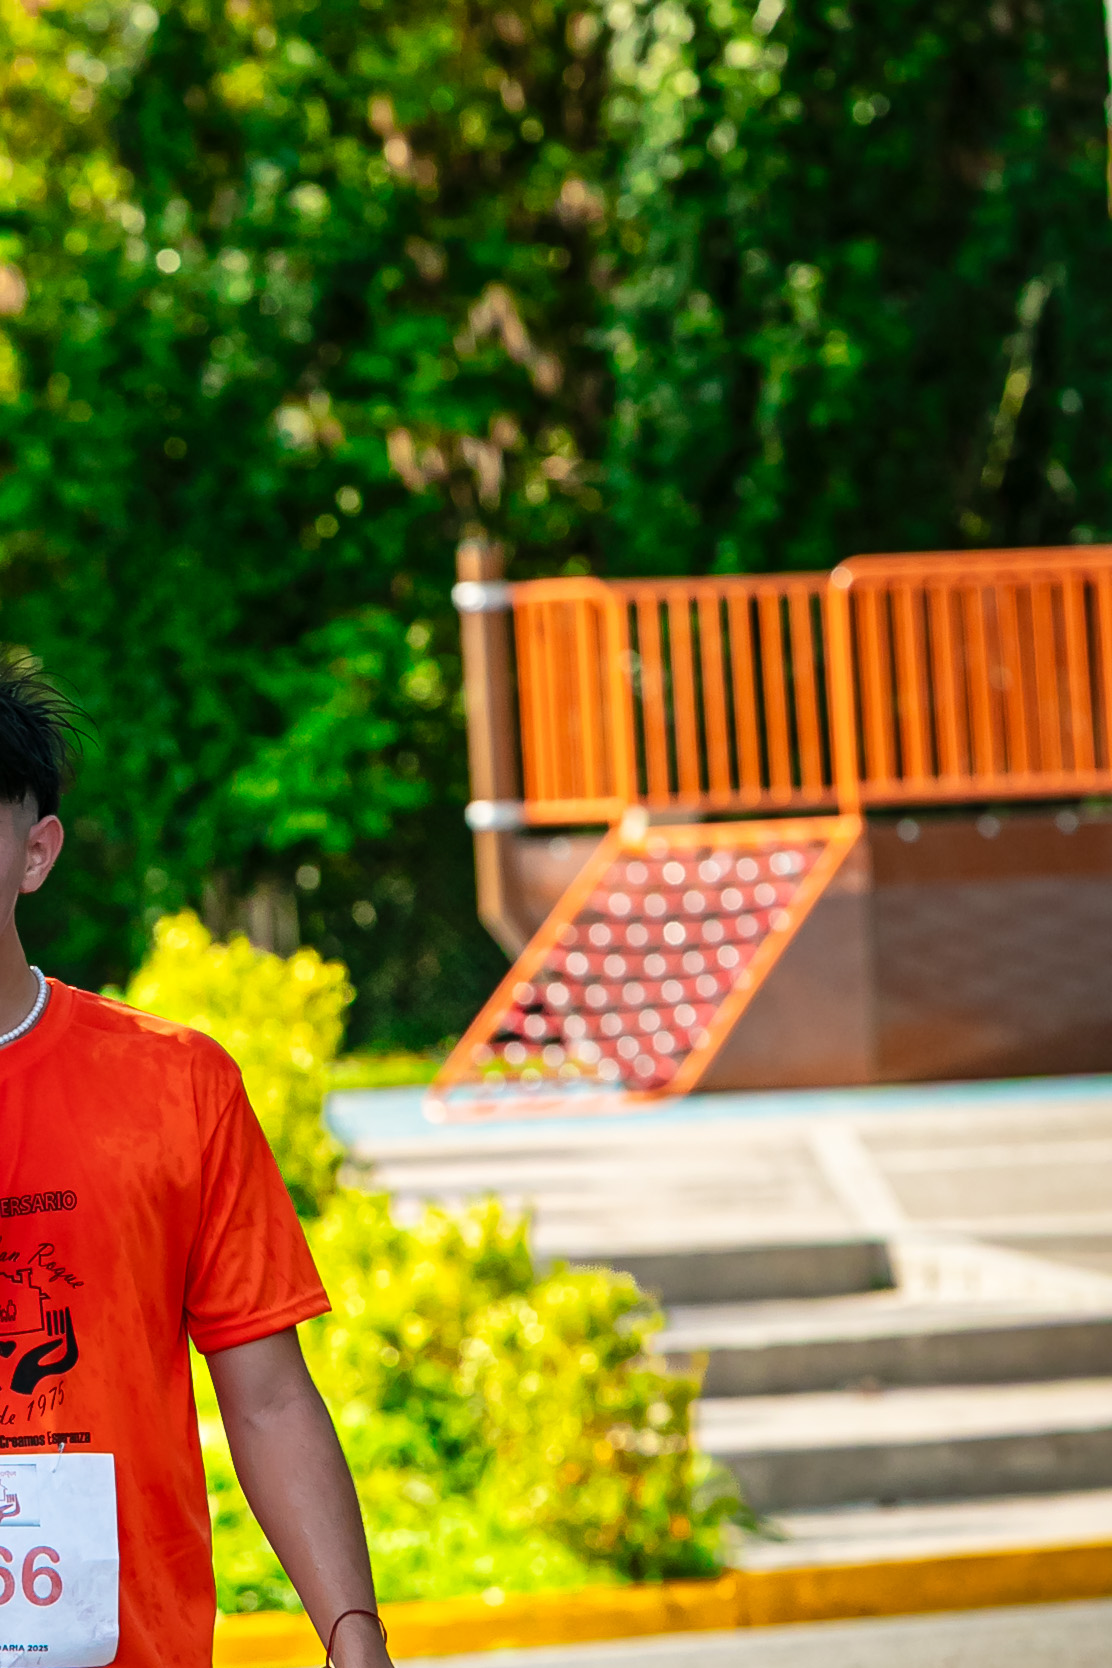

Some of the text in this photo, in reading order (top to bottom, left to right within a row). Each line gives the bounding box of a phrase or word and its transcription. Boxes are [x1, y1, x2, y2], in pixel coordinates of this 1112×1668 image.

[26, 1380, 65, 1422] 1975
[0, 1434, 45, 1449] Creamos
[27, 1644, 49, 1652] 2025
